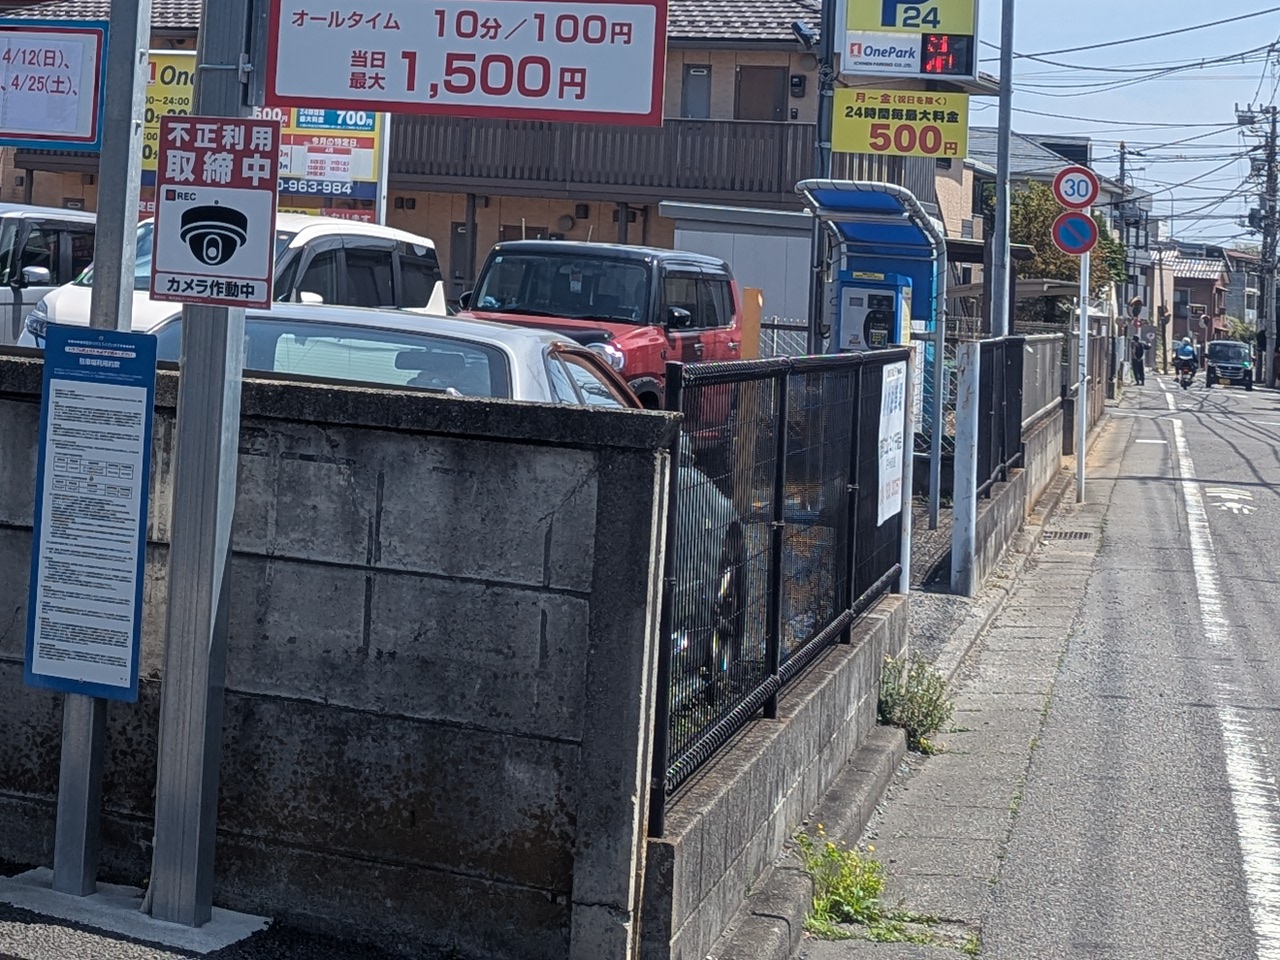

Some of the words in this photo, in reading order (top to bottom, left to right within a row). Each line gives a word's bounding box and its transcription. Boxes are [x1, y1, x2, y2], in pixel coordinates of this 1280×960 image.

[291, 10, 401, 31] オールタイム
[902, 6, 940, 28] 24
[350, 50, 386, 69] 当日
[864, 45, 916, 59] OnePark
[349, 72, 386, 90] 最大
[400, 51, 587, 100] 1,500円
[337, 111, 372, 126] 700円
[845, 106, 959, 123] 24時間毎最大料金
[167, 122, 273, 152] 不正利用
[869, 123, 958, 155] 500円
[165, 149, 271, 187] 取締中
[177, 191, 197, 201] REC
[1064, 178, 1089, 198] 30
[167, 277, 255, 299] カメラ作動中
